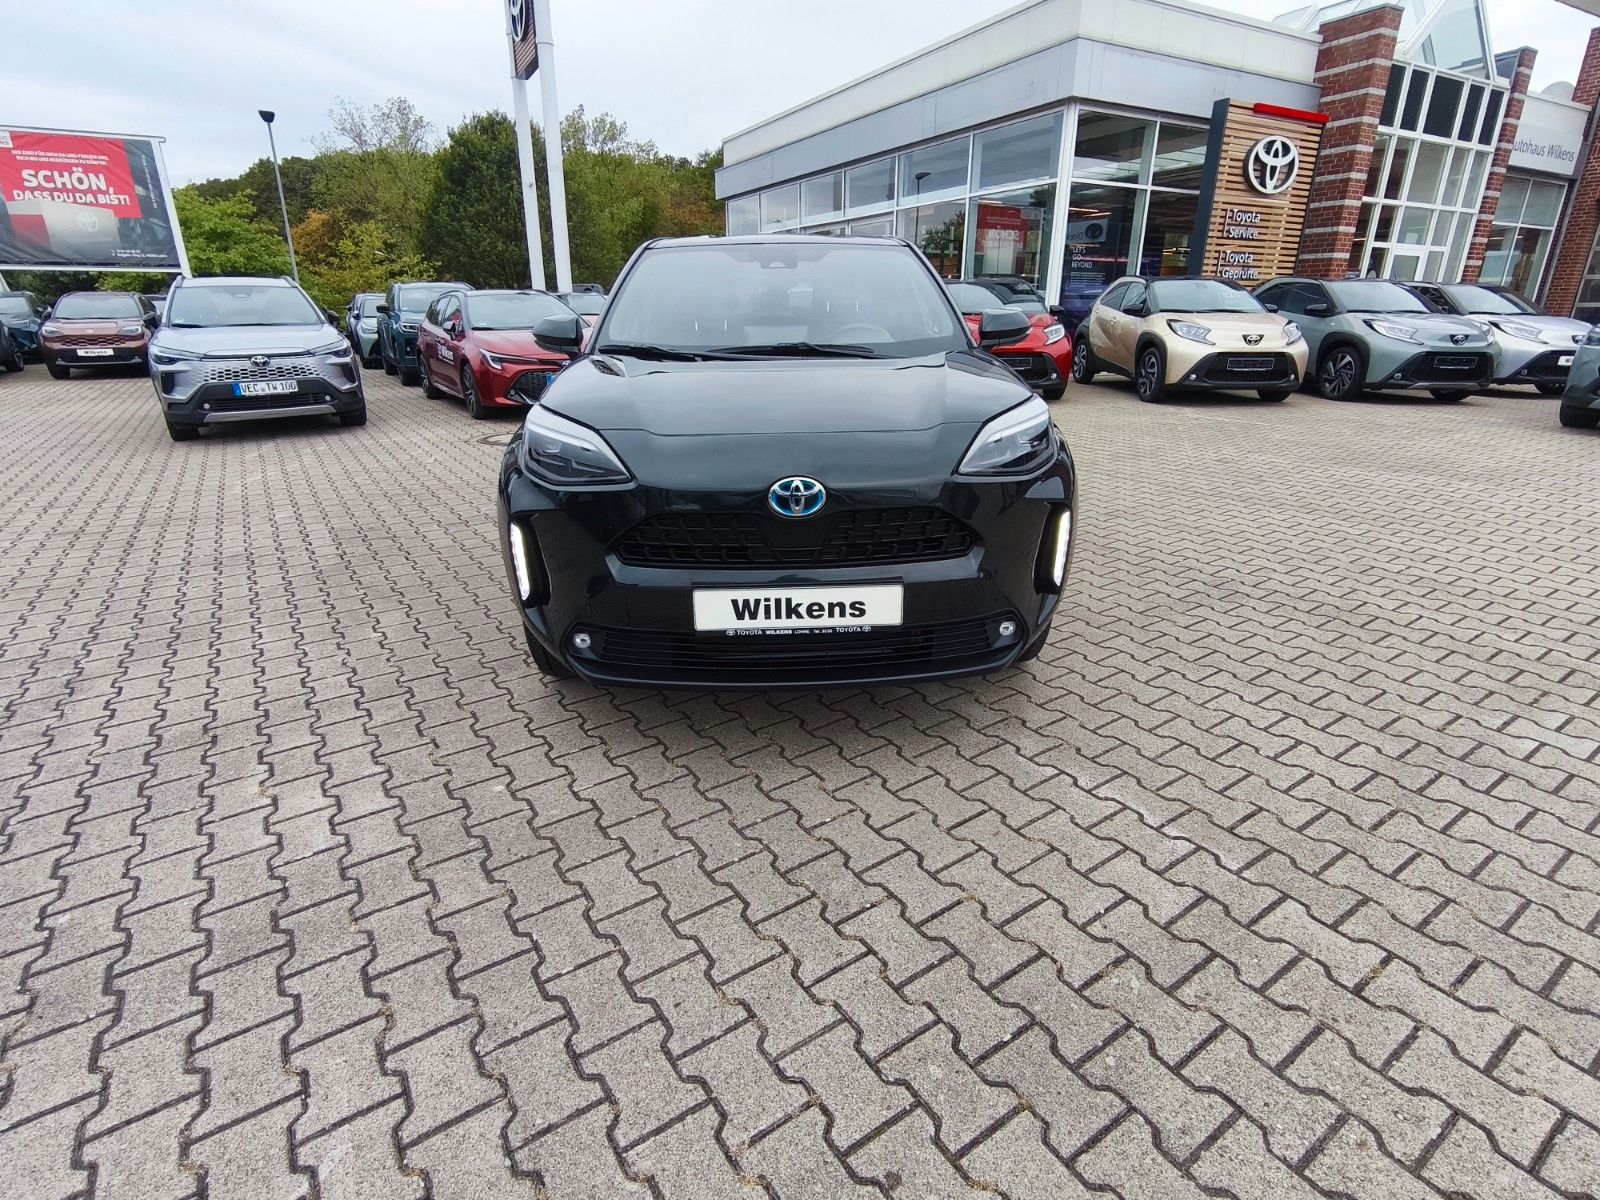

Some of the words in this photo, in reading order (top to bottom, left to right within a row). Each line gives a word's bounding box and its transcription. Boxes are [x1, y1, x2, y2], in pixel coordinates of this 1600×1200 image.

[1512, 139, 1546, 157] utohaus
[1547, 144, 1576, 162] Wilkens
[21, 166, 114, 194] SCHÖN,
[12, 189, 53, 202] DASS
[53, 192, 73, 203] DU
[75, 193, 95, 204] DA
[97, 194, 131, 206] BIST!
[1232, 208, 1261, 224] Toyota
[1228, 226, 1259, 239] Service
[1072, 253, 1082, 261] GO
[1225, 250, 1254, 265] Toyota
[1071, 261, 1093, 269] BEYOND
[1222, 267, 1259, 280] Geprüfte
[241, 383, 260, 393] VEC
[265, 382, 278, 392] TW
[279, 381, 297, 391] 100
[730, 597, 867, 621] Wilkens
